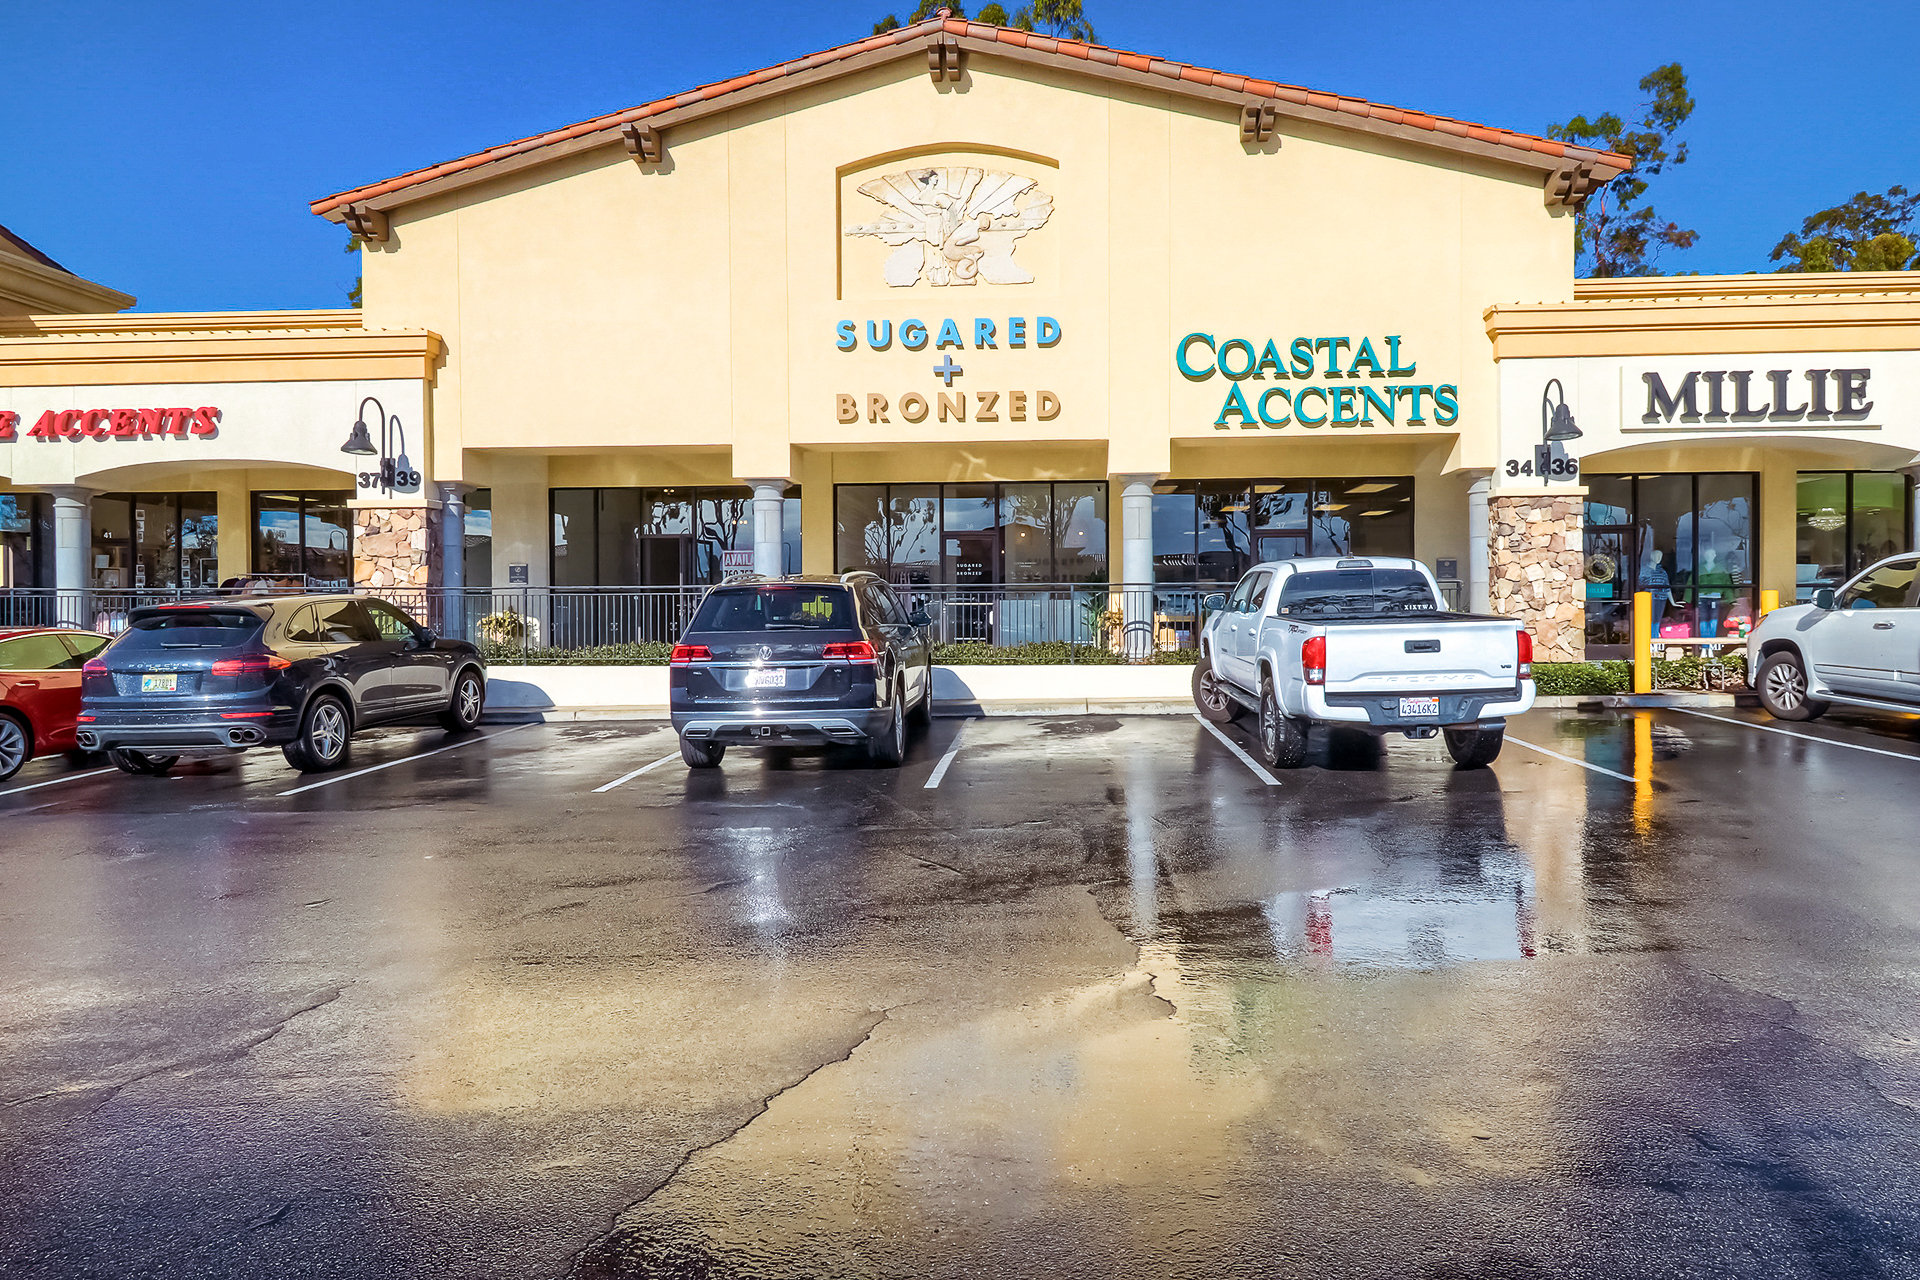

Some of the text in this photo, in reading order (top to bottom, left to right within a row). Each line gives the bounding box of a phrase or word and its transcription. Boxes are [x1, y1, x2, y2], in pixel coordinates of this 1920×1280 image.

[836, 317, 1062, 351] SUGARED
[1176, 332, 1416, 381] COASTAL
[836, 391, 1062, 424] BRONZED
[1214, 381, 1459, 430] ACCENTS
[1641, 368, 1874, 424] MILLIE
[27, 407, 220, 440] ACCENTS
[358, 471, 421, 488] 37 39
[1506, 458, 1578, 477] 34 36
[103, 531, 113, 539] 41
[1401, 703, 1438, 715] 43416K2
